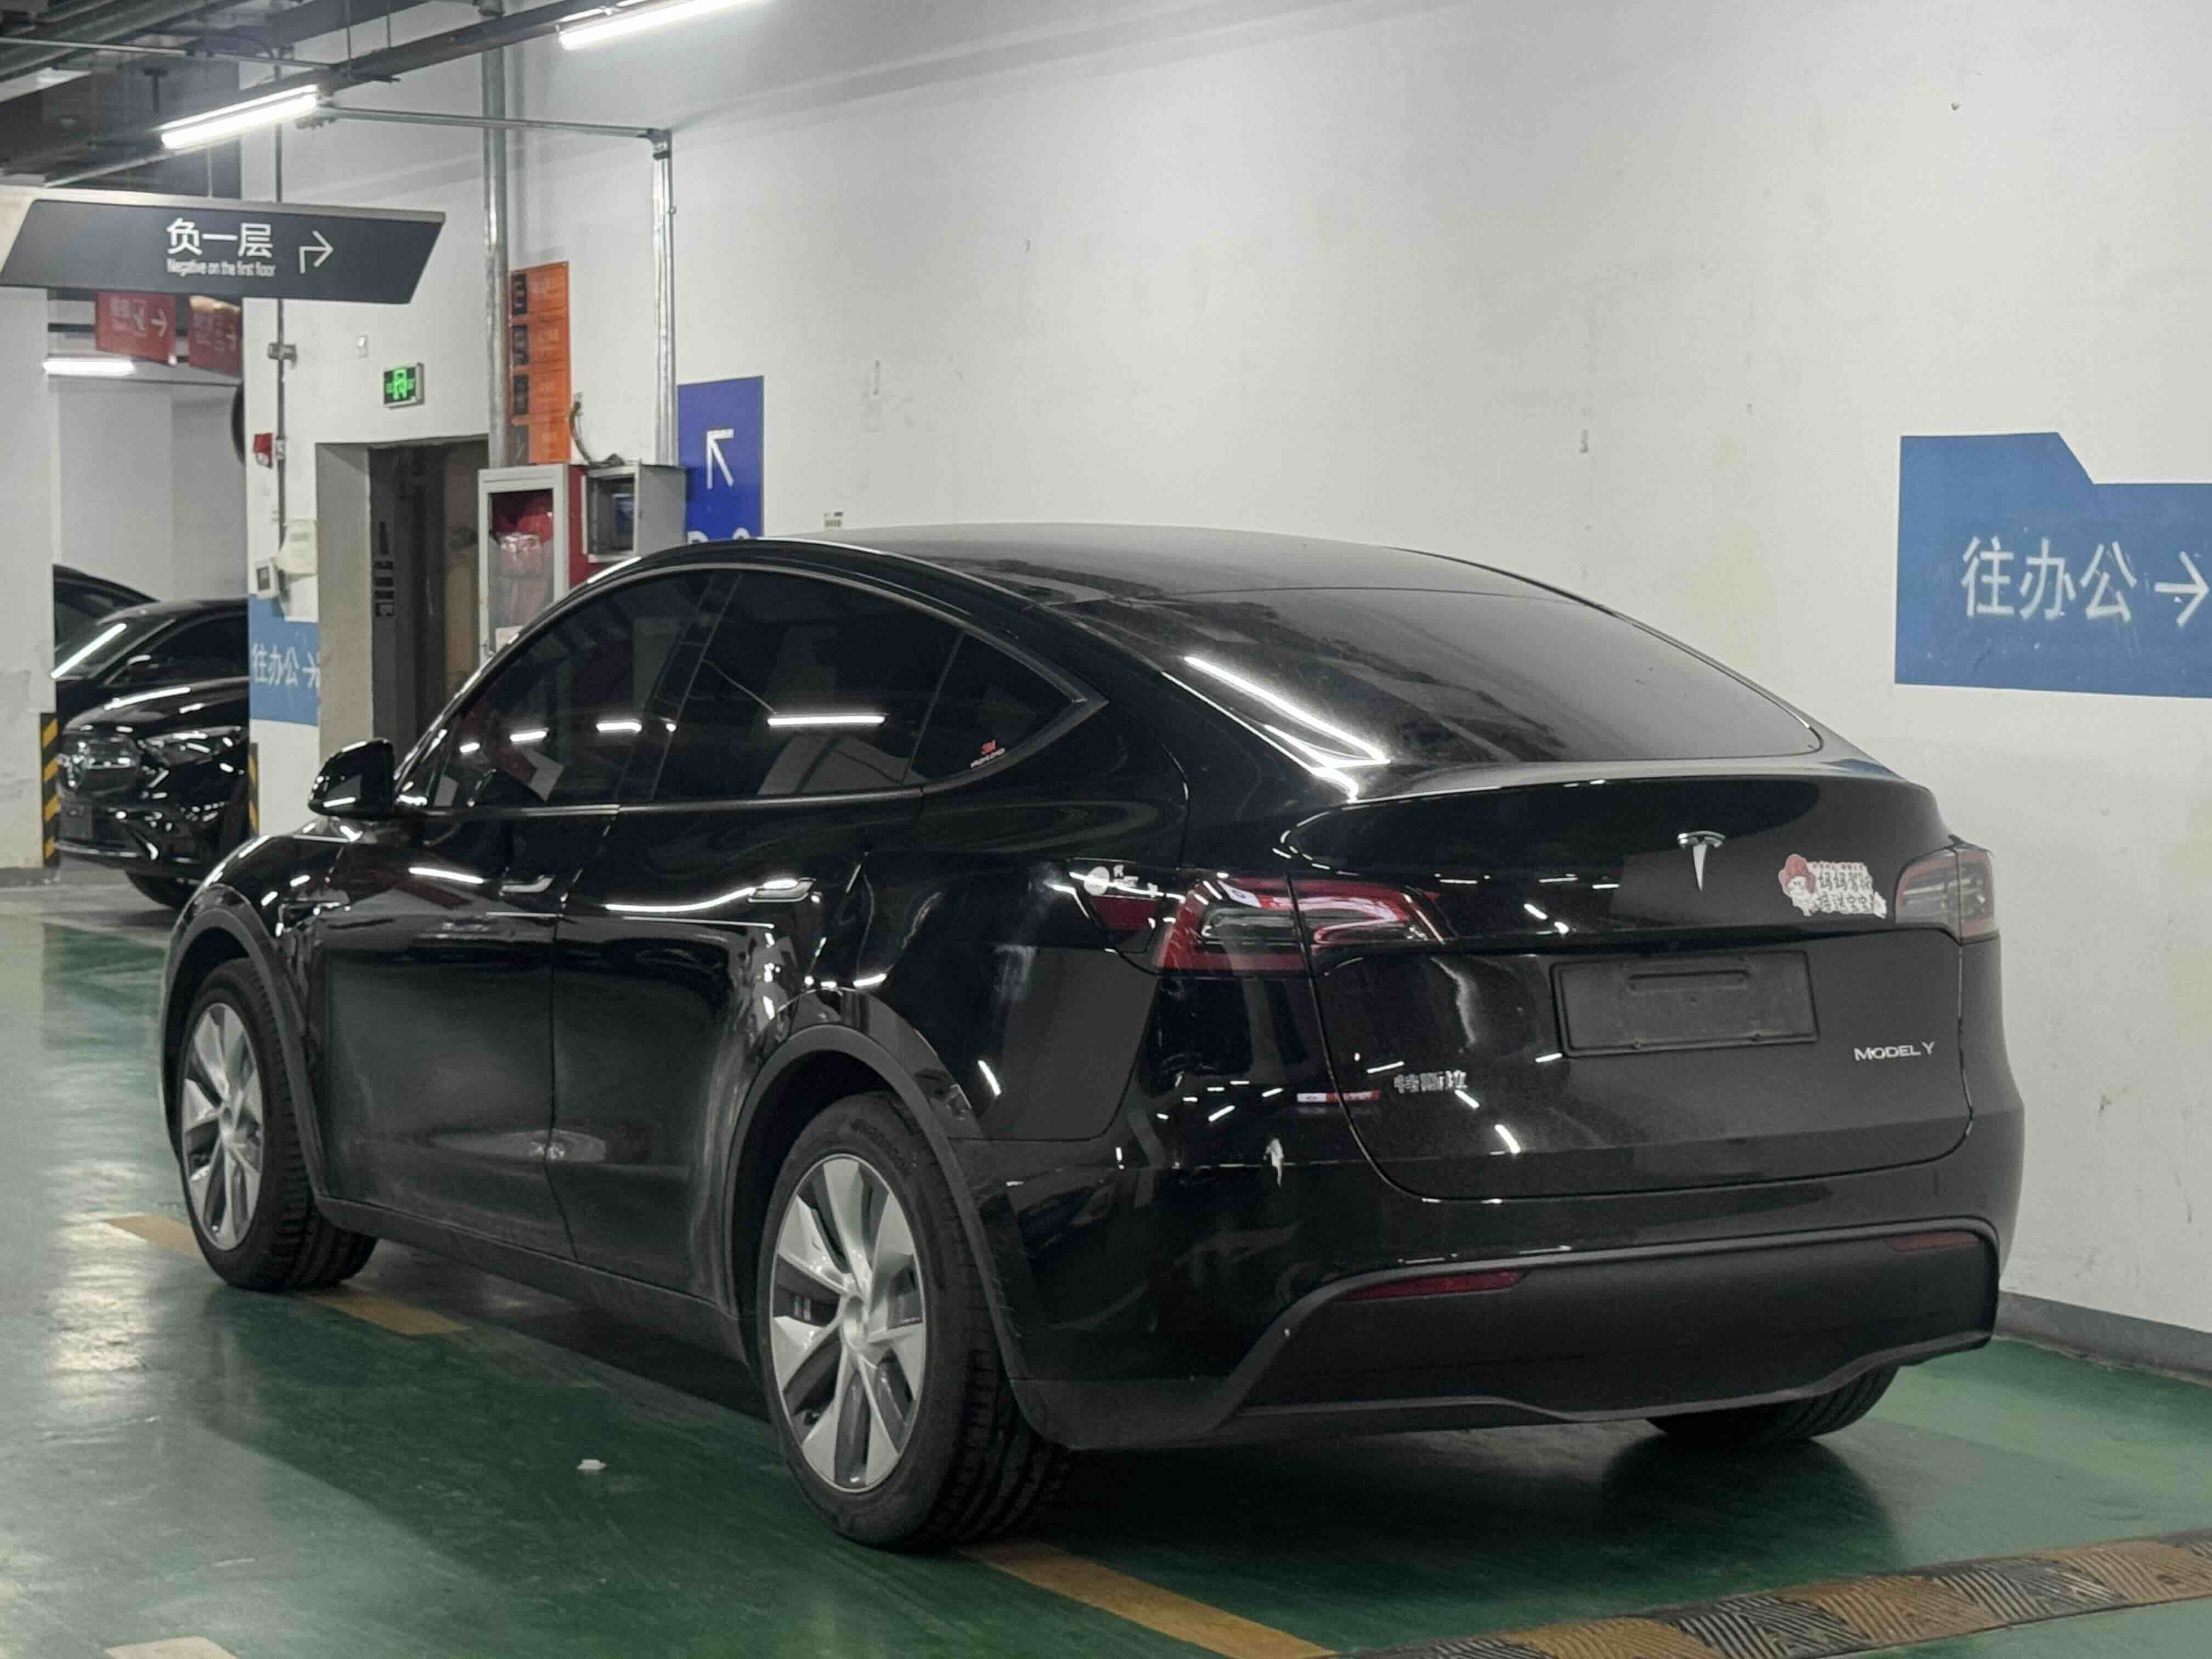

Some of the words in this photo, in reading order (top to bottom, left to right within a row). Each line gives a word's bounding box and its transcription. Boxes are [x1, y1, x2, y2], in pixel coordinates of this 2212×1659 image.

[166, 217, 273, 258] 负一层
[208, 262, 219, 275] on
[221, 261, 236, 276] the
[237, 260, 255, 276] first
[1960, 535, 2138, 623] 往办公
[250, 643, 300, 687] 往办公
[1853, 1045, 1921, 1062] MODEL
[1921, 1041, 1935, 1055] Y
